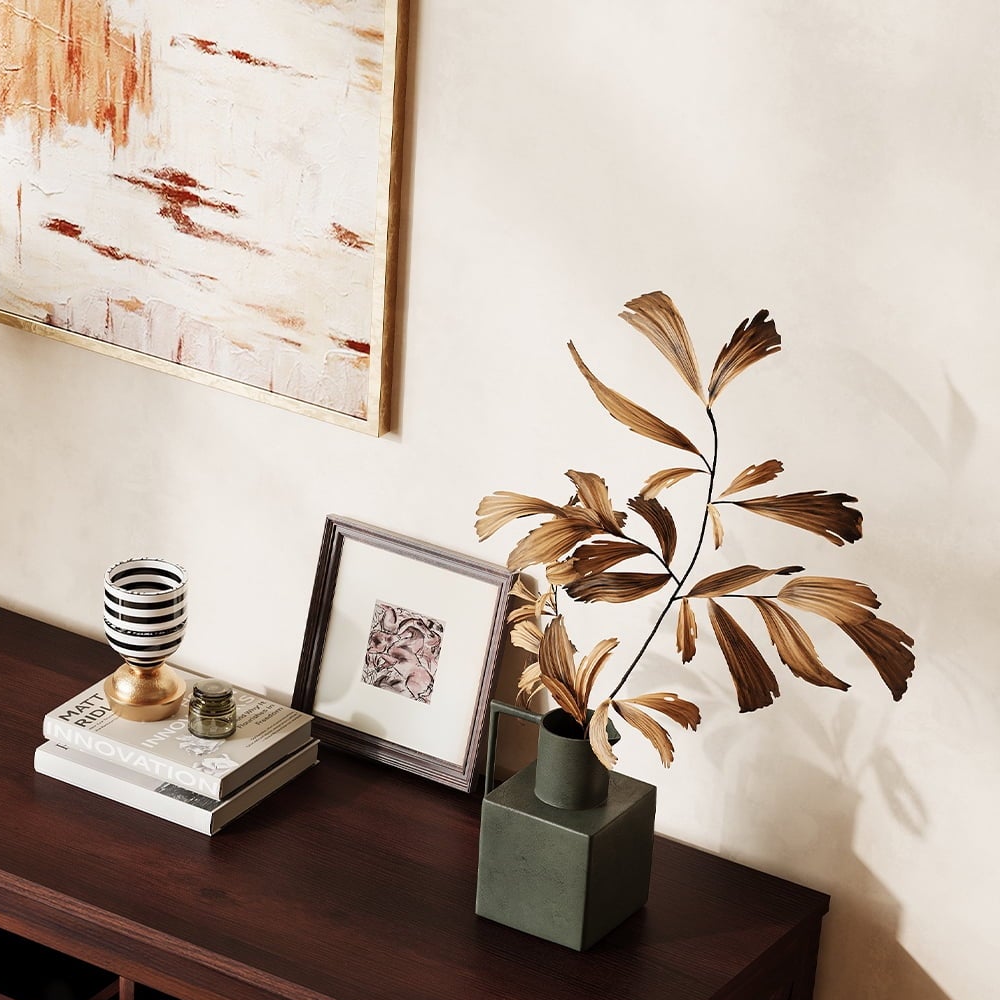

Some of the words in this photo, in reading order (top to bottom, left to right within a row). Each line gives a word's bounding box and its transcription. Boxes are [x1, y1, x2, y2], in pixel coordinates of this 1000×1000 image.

[58, 693, 104, 721] MATT
[74, 706, 112, 727] RIDL
[46, 721, 219, 795] INNOVATION
